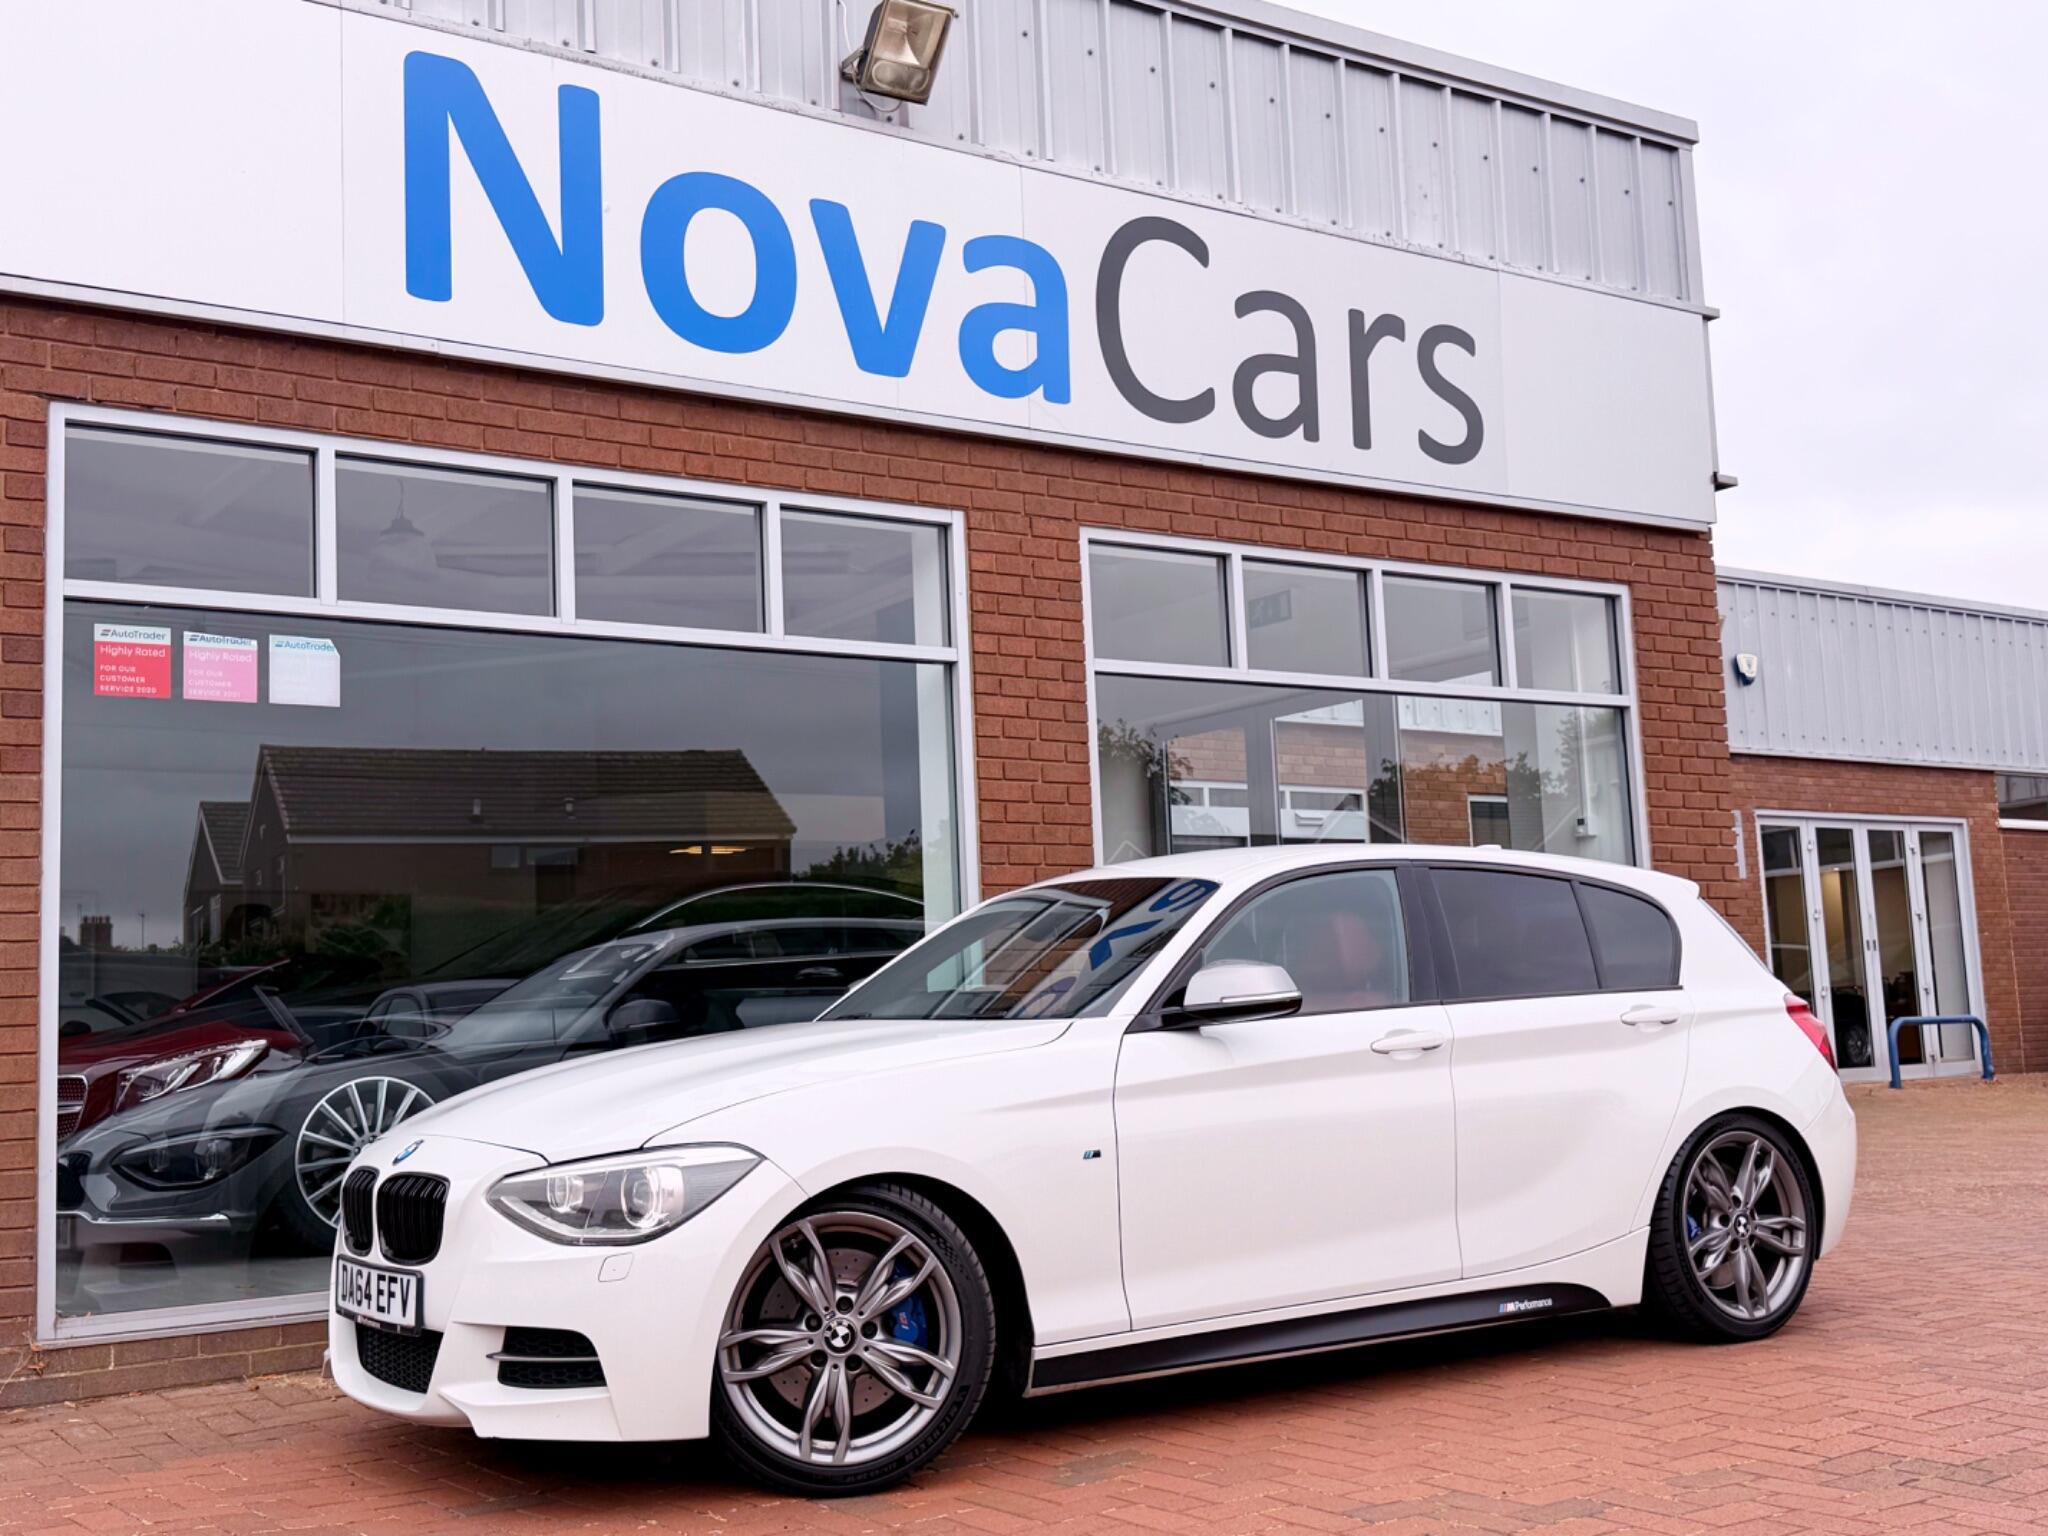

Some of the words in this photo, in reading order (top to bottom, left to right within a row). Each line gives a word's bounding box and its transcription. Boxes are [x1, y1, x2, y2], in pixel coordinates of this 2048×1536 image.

[403, 50, 1484, 464] NovaCars
[111, 629, 166, 640] AutoTrader
[100, 644, 133, 658] Highly
[135, 647, 166, 658] Rated
[285, 640, 335, 651] AutoTrade
[222, 652, 252, 663] Rated
[118, 665, 136, 673] OUR
[100, 674, 145, 683] CUSTOMER
[100, 684, 134, 693] SERVICE
[341, 1263, 372, 1310] DA64
[376, 1273, 411, 1318] EFV
[904, 1404, 958, 1463] MICHELIN
